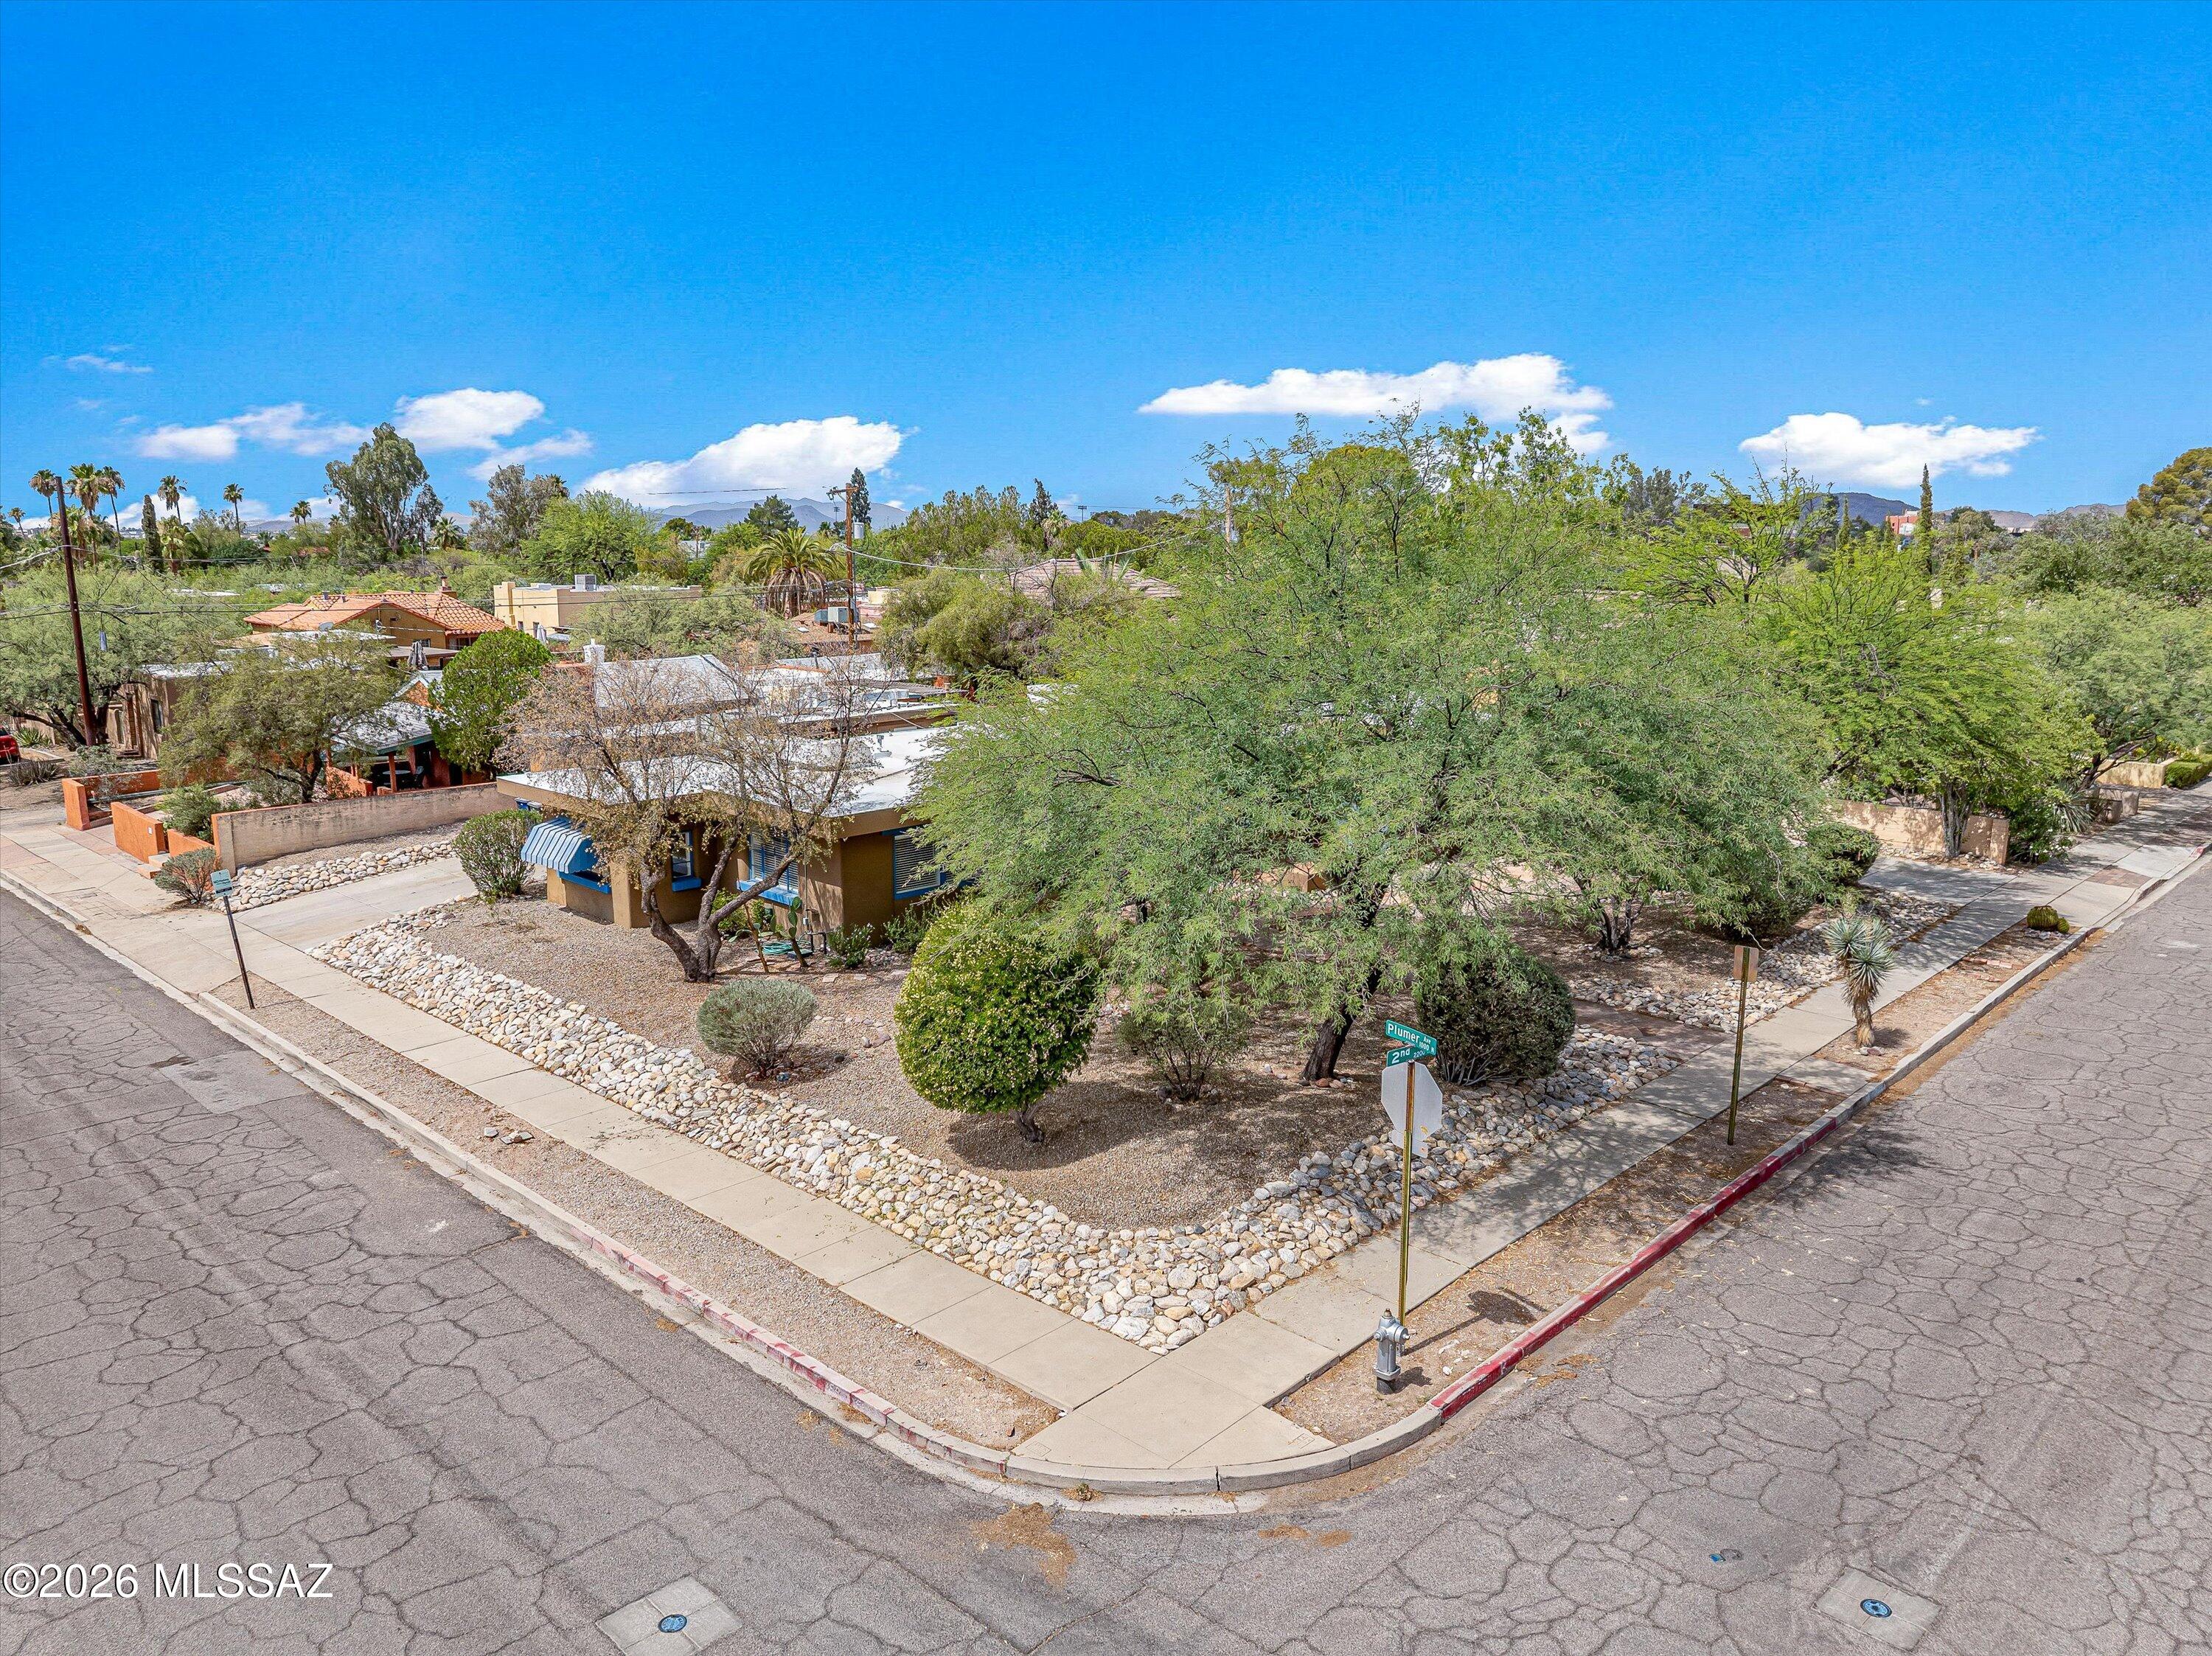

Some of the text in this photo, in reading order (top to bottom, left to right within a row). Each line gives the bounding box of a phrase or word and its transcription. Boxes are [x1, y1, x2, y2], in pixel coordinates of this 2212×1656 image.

[1388, 1023, 1431, 1045] Plumer Ave
[1419, 1042, 1429, 1051] 1000
[1391, 1048, 1411, 1064] 2nd
